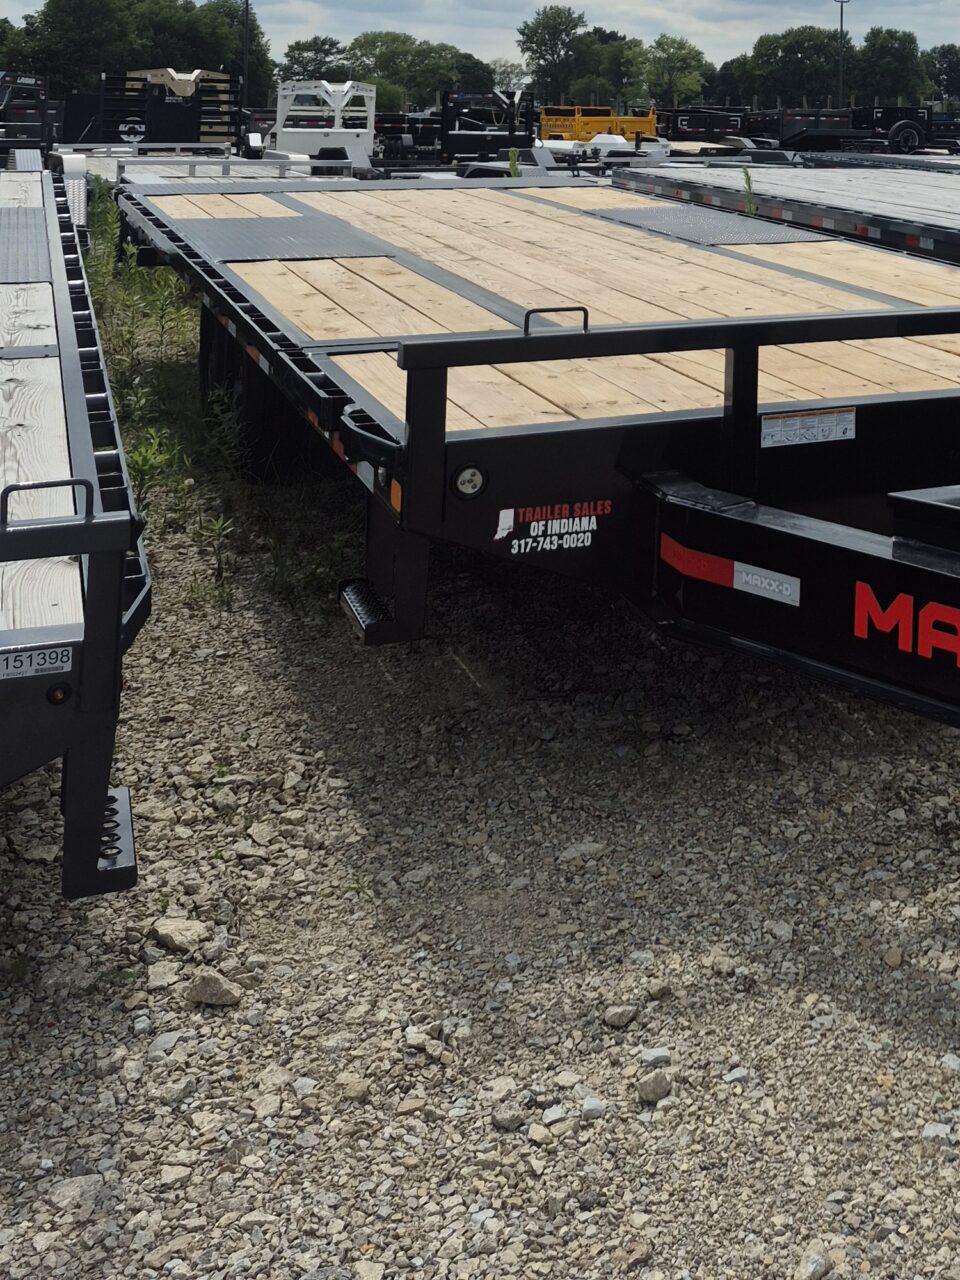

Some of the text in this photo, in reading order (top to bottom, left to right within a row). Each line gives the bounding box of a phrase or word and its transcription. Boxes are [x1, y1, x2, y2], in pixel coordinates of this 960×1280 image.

[517, 500, 613, 522] TRAILER SALES
[530, 515, 598, 536] OF INDIANA
[510, 532, 592, 555] 317-743-0020
[741, 571, 791, 596] MAXX-D
[2, 648, 71, 670] 151398
